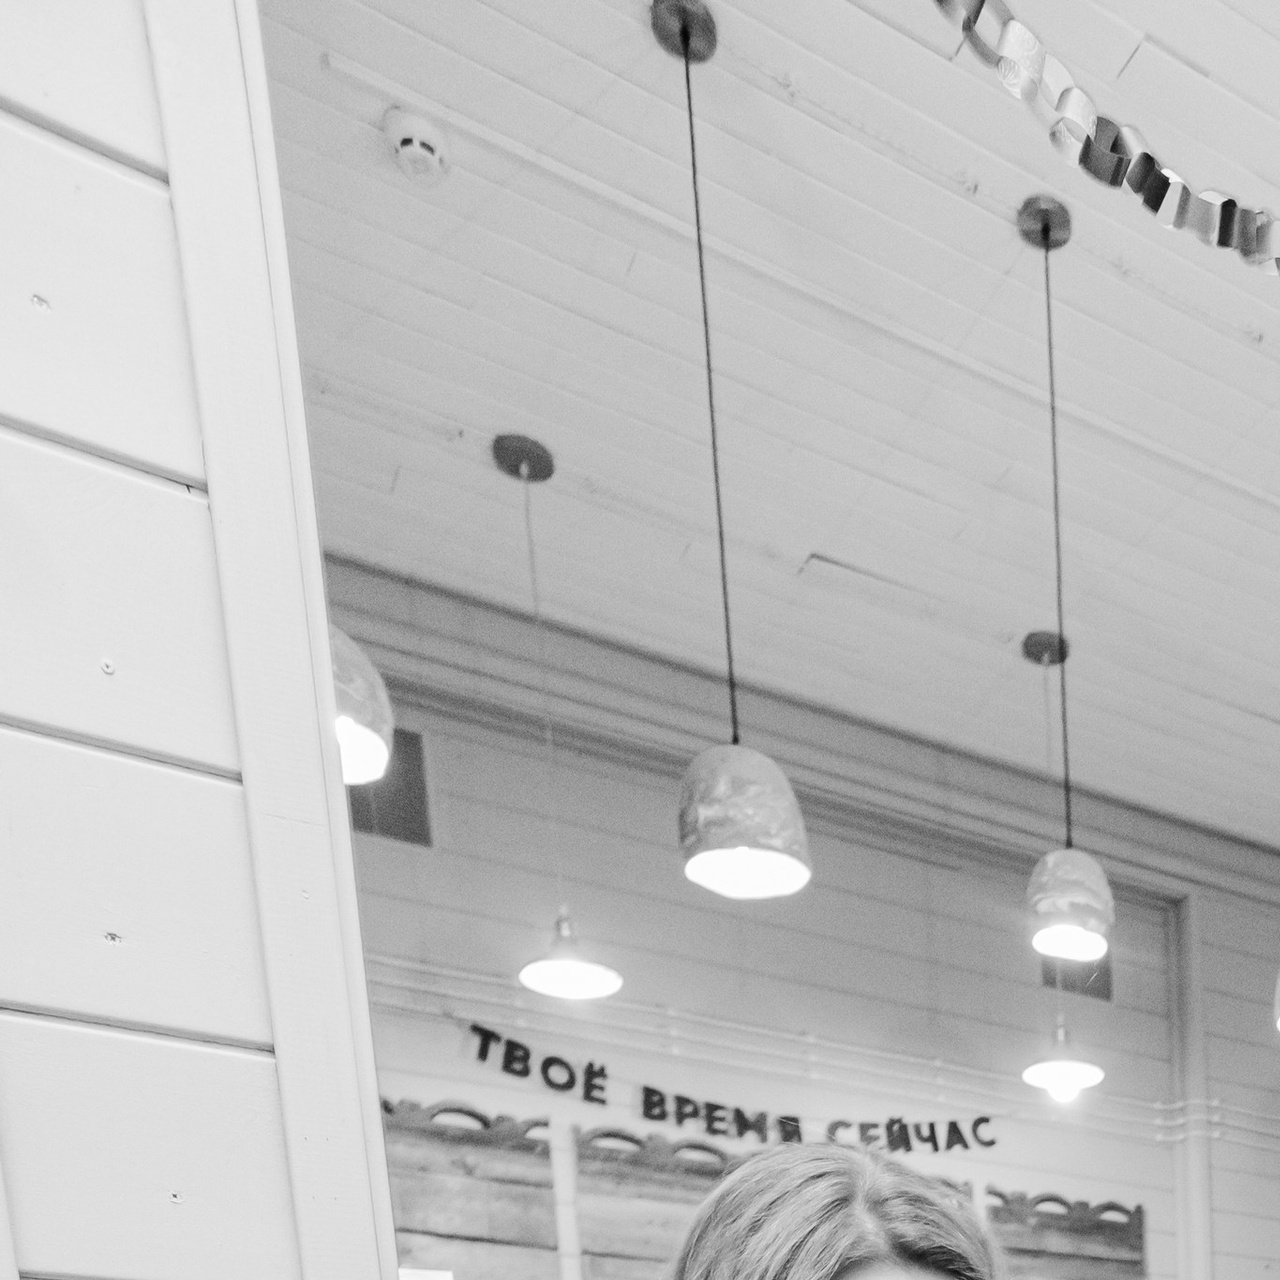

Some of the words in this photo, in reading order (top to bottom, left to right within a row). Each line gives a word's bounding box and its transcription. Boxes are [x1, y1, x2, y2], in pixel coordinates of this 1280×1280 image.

[470, 1023, 608, 1105] ТВОЁ
[641, 1085, 802, 1144] ВРЕМЯ
[827, 1115, 997, 1153] СЕЙЧАС
